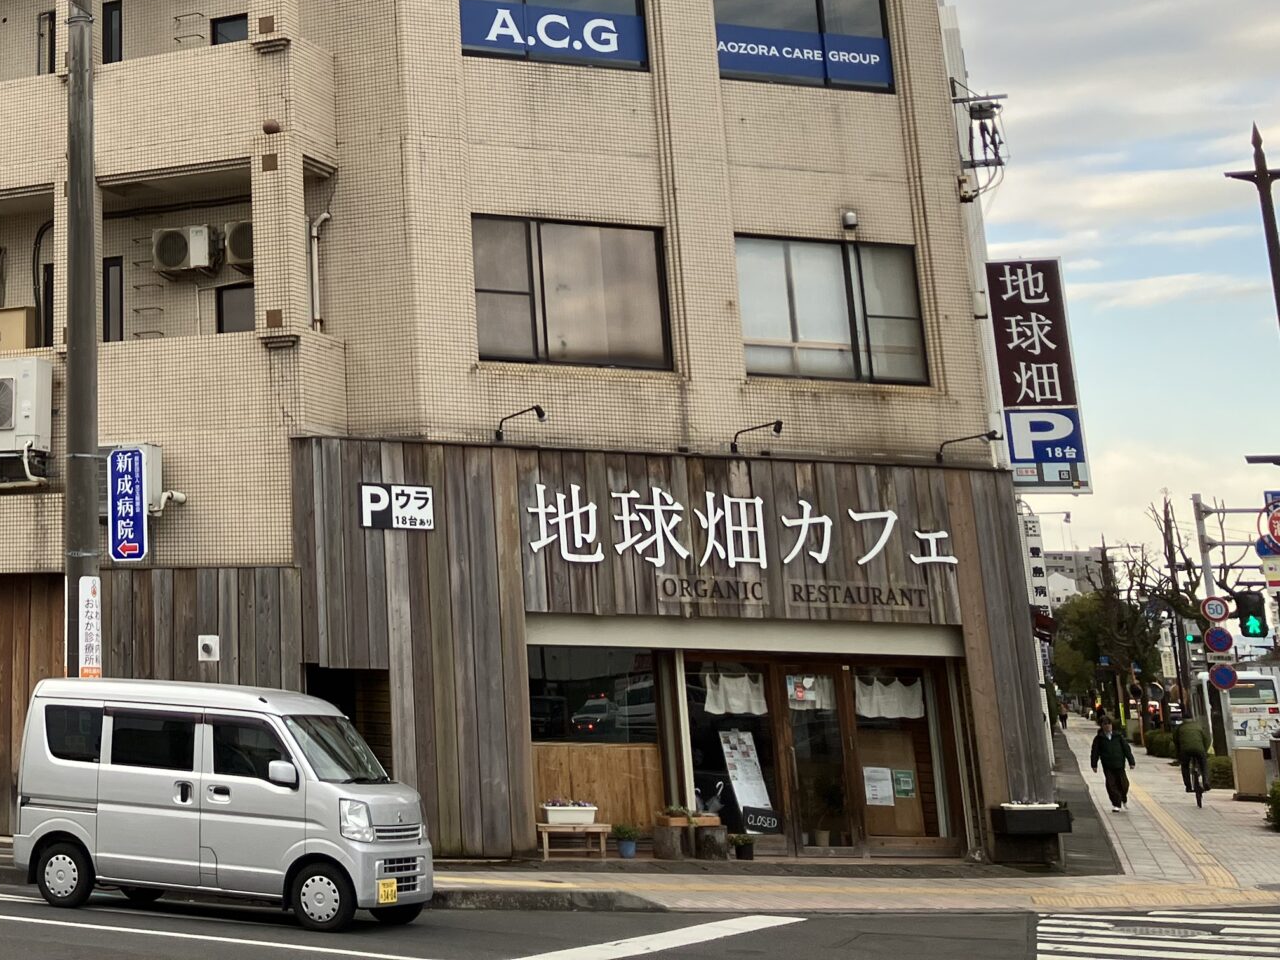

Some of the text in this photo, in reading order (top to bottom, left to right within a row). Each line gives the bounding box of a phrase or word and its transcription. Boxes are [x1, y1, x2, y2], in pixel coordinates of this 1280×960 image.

[485, 8, 619, 52] A.C.G
[717, 41, 880, 65] AOZORA CARE GROUP
[998, 263, 1063, 403] 地球畑
[1009, 412, 1074, 460] P
[1045, 445, 1077, 459] 18台
[115, 452, 134, 540] 新成病院
[361, 485, 390, 527] P
[395, 489, 430, 510] ウラ
[395, 515, 432, 527] 18台あり
[527, 483, 959, 570] 地球畑カフェ
[662, 577, 928, 608] ORGANIC RESTAURANT
[1207, 603, 1223, 615] 50
[84, 599, 95, 665] おなか診療所
[747, 814, 778, 828] CLOSED
